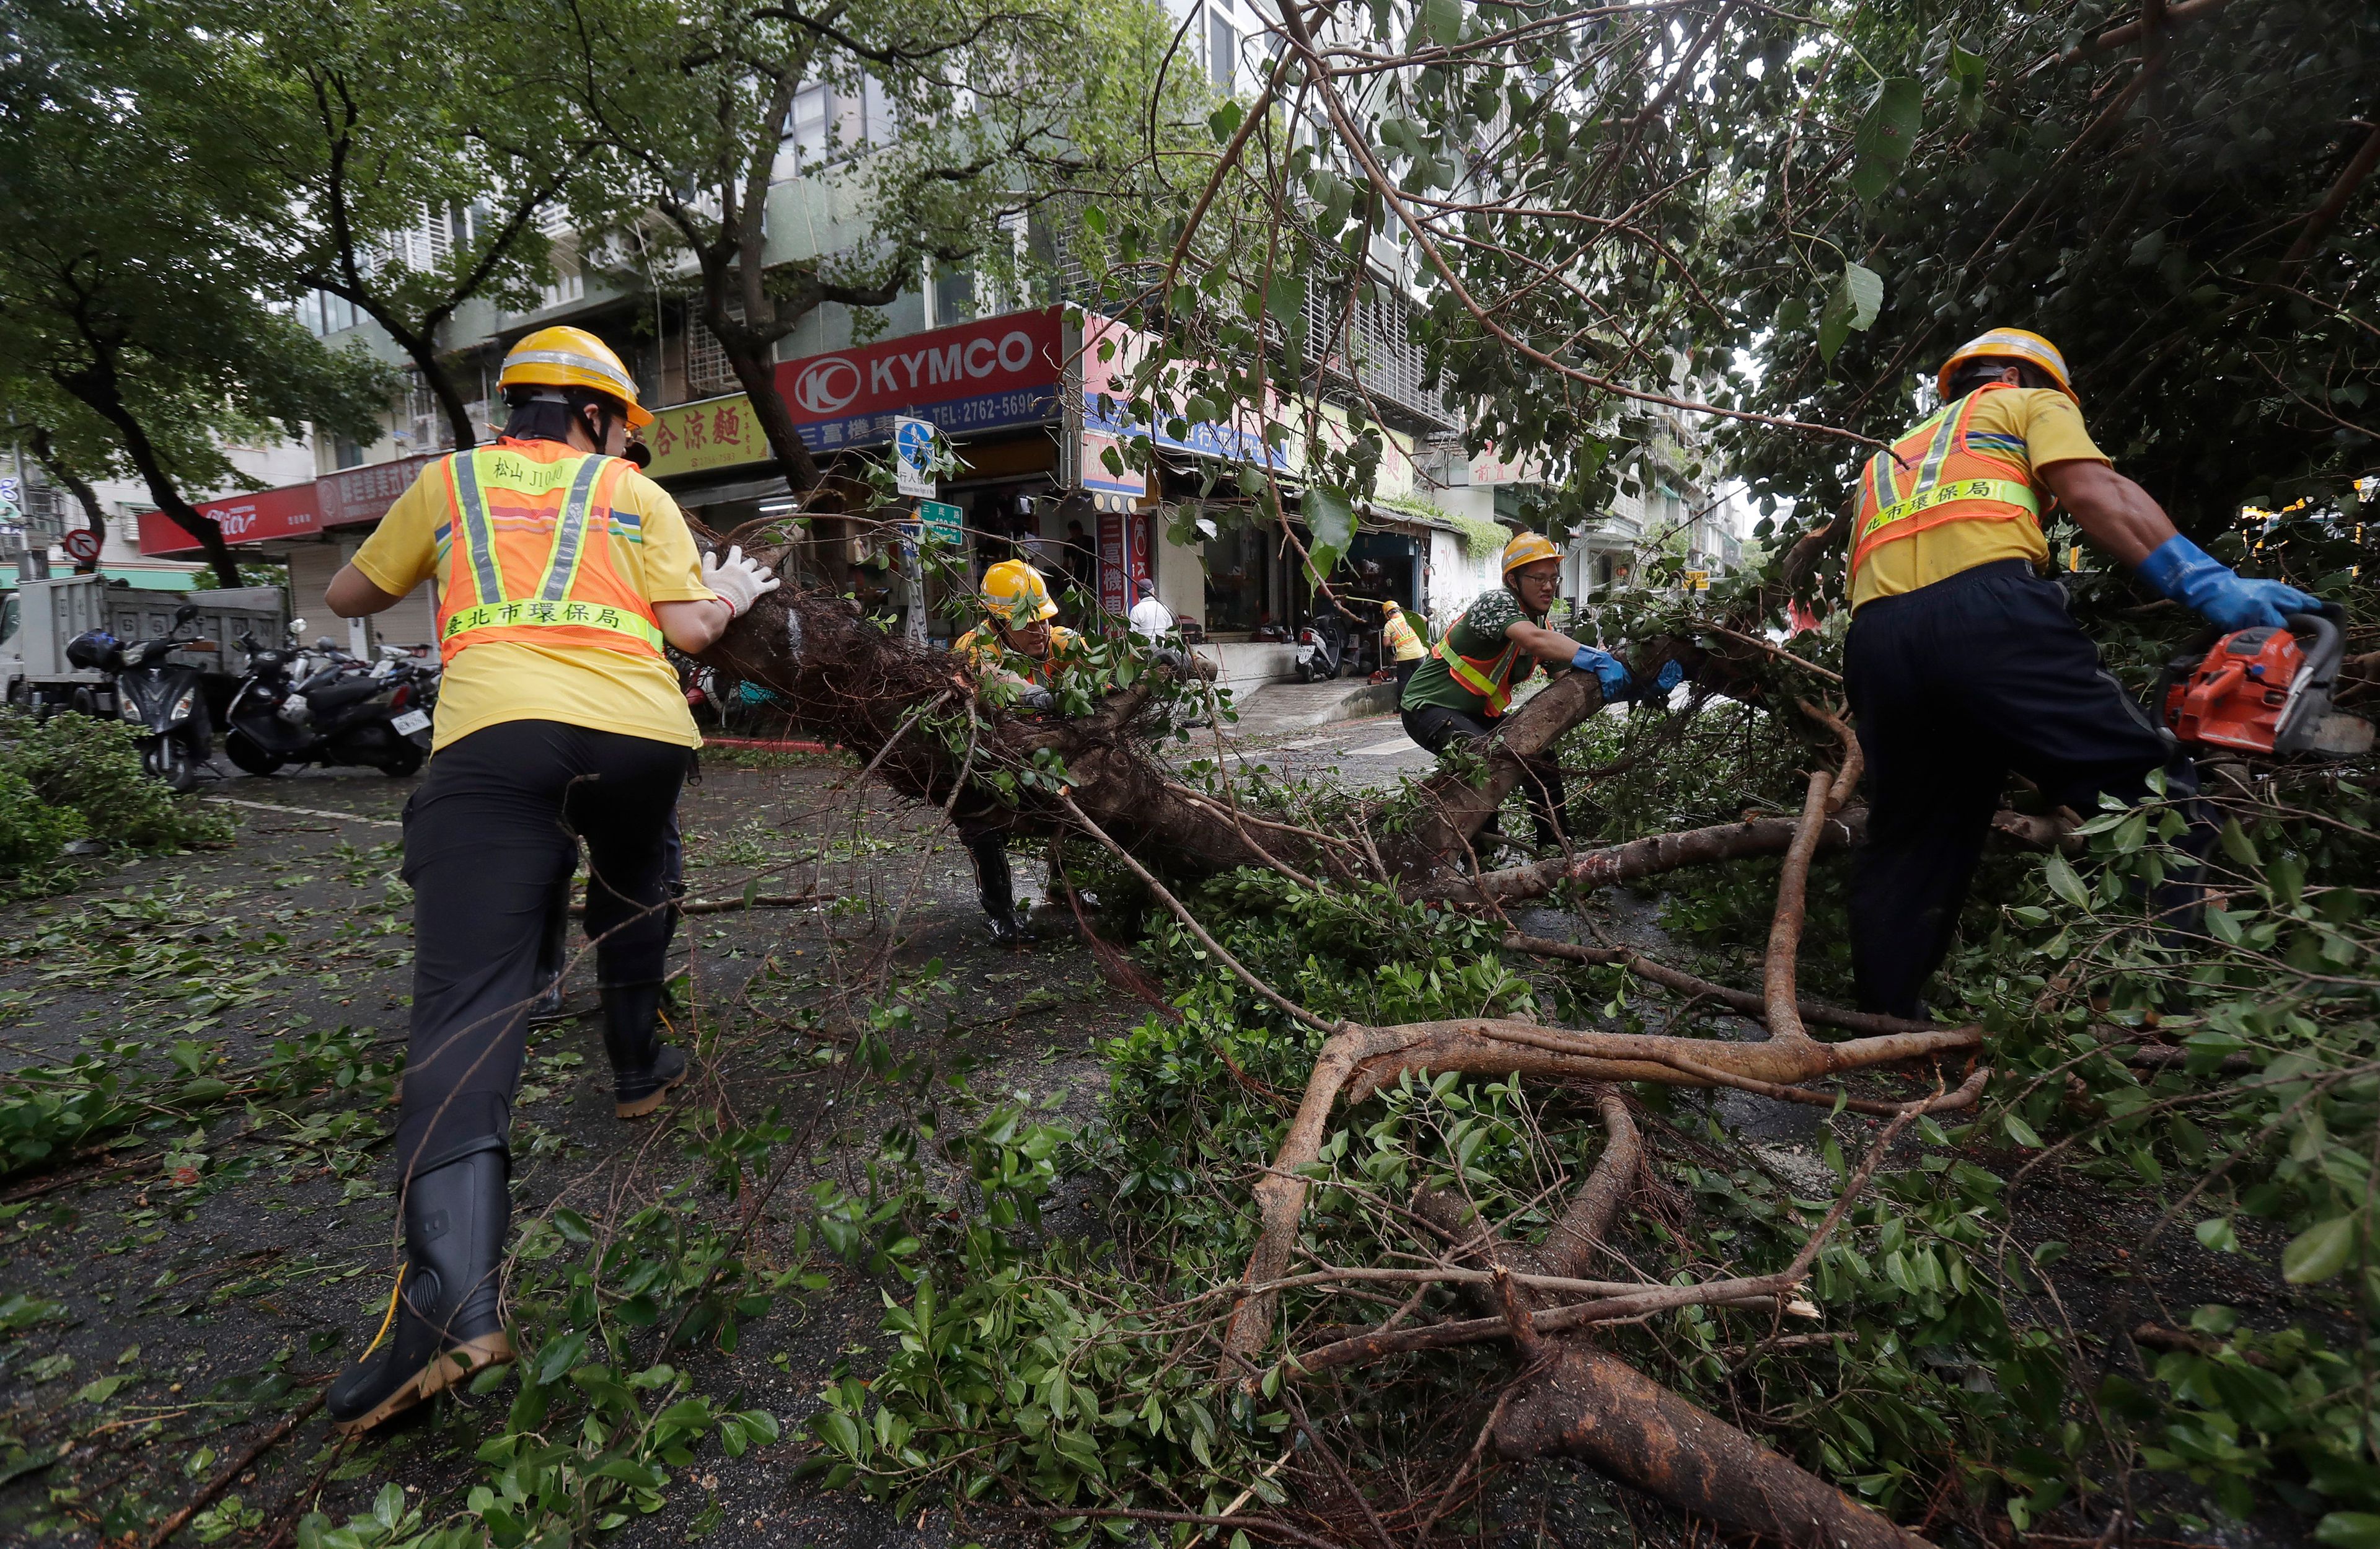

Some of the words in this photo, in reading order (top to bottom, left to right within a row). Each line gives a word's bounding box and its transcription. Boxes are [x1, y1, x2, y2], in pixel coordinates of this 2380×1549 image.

[871, 330, 1033, 394] KYMCO
[493, 457, 523, 482] 松山
[899, 471, 935, 487] 行人優
[922, 505, 960, 519] 三民路
[444, 602, 620, 638] 臺北市環保局
